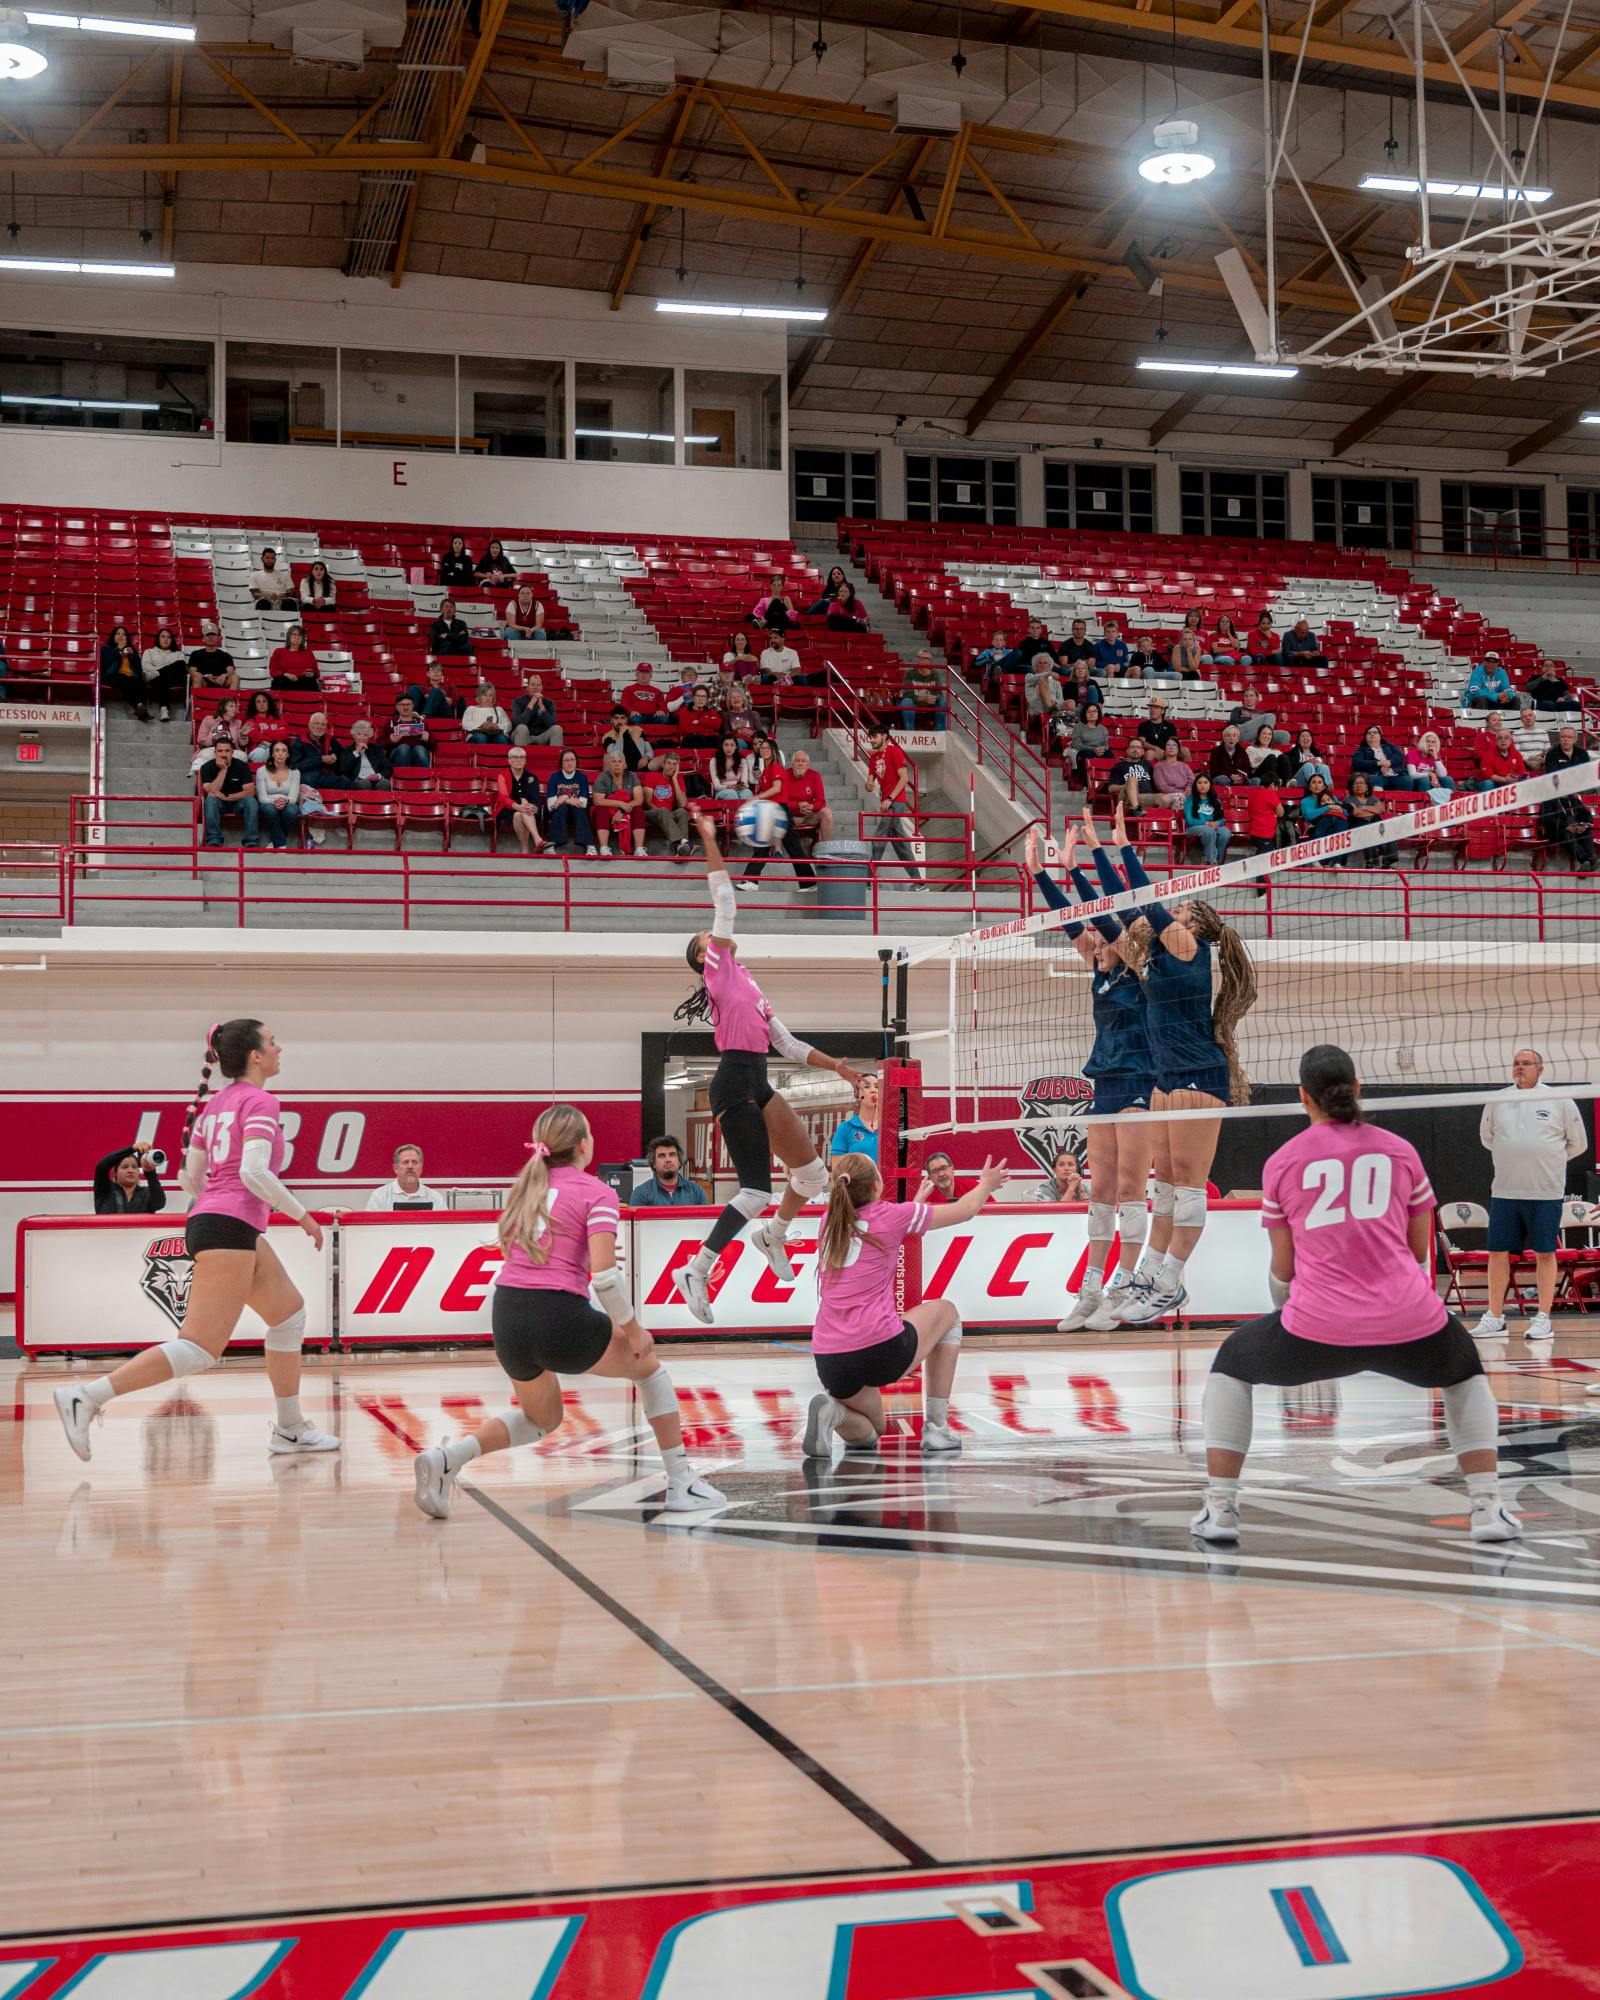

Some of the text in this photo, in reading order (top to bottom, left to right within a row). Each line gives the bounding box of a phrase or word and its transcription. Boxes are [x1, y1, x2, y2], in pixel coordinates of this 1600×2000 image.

[393, 462, 407, 486] E
[52, 711, 81, 721] AREA
[911, 736, 937, 746] AREA
[20, 745, 40, 761] EXIT
[1129, 764, 1145, 773] AIR
[1414, 785, 1517, 829] NEW MEXICO LOBOS
[93, 828, 100, 839] E
[915, 843, 922, 854] E
[1047, 846, 1056, 857] D
[1270, 831, 1351, 867] NEW MEXICO LOBOS
[1154, 867, 1220, 898] NEW MEXICO LOBOS
[1060, 896, 1114, 921] NEW MEXICO LOBOS
[1023, 1077, 1094, 1100] LOBOS
[1302, 1153, 1392, 1231] 20
[147, 1238, 189, 1257] LOB
[643, 1230, 1121, 1305] MEICO
[353, 1246, 591, 1314] NE
